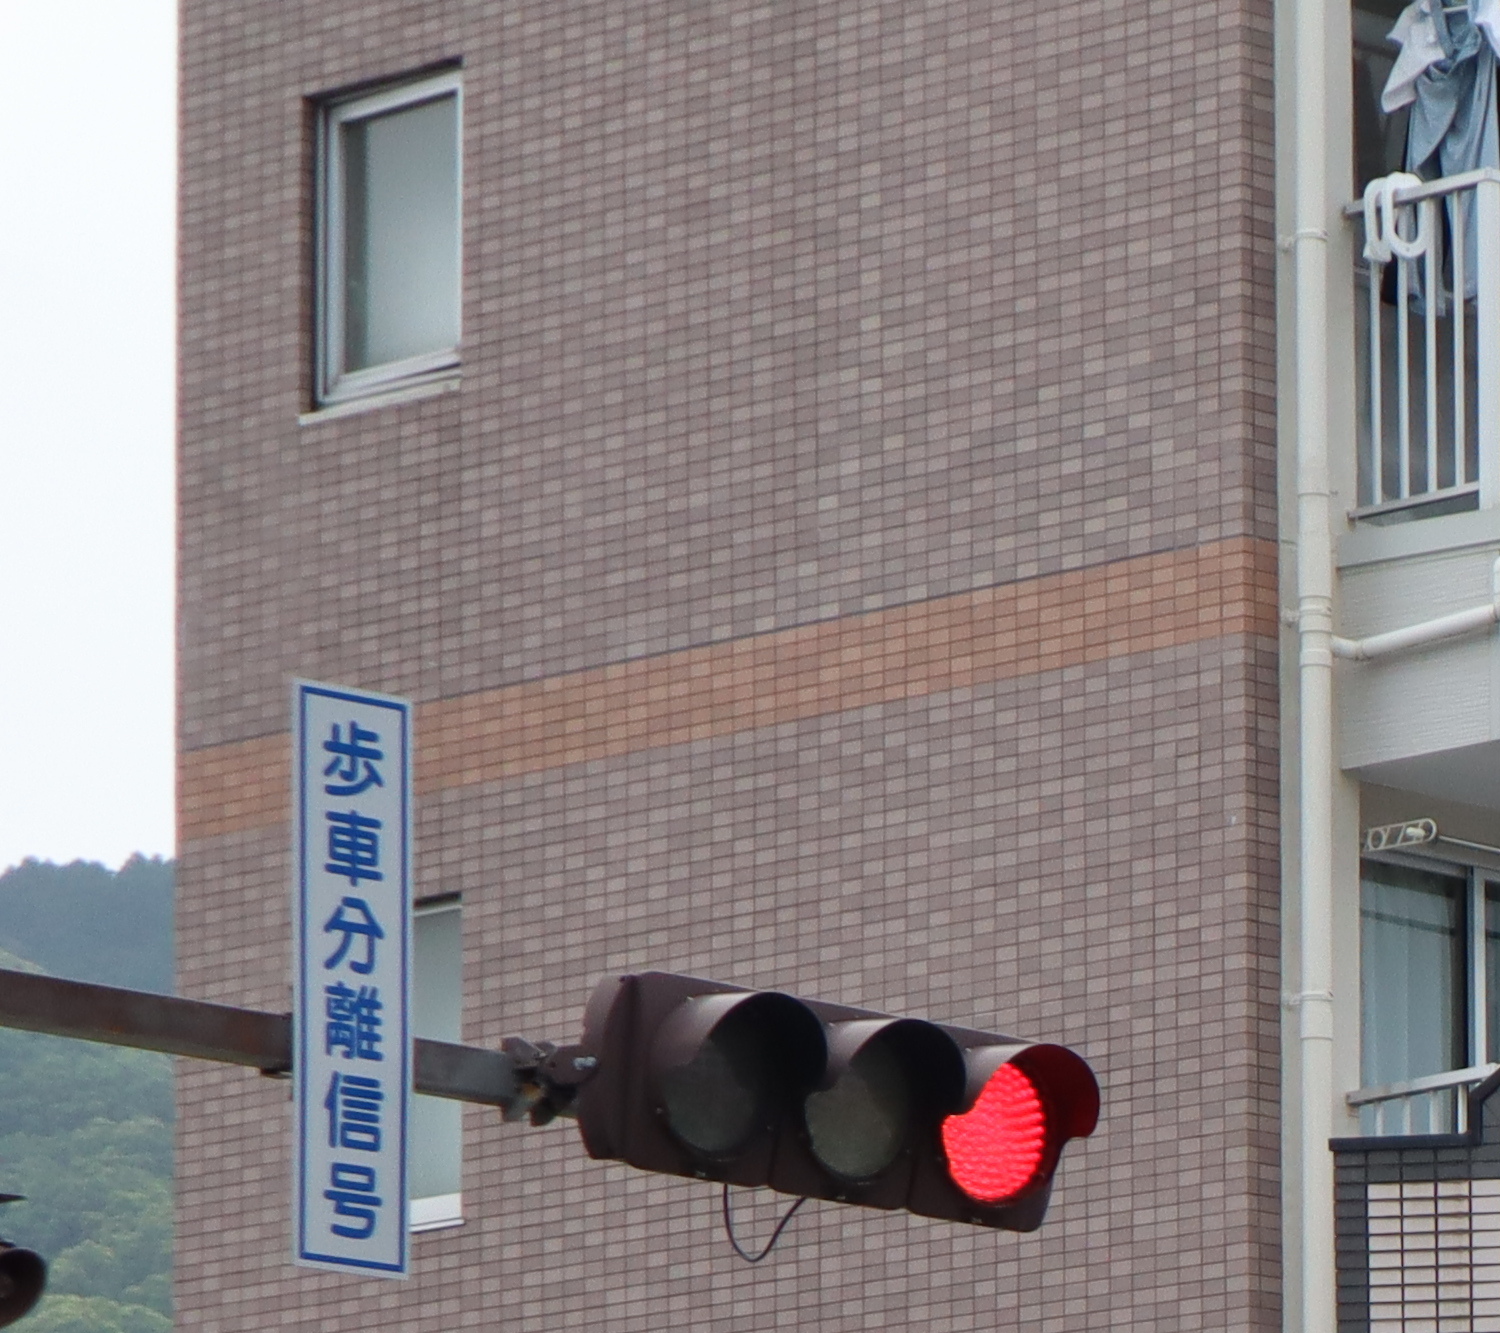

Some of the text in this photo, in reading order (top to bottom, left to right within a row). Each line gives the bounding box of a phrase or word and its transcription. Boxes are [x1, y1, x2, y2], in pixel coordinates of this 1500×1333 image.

[321, 720, 386, 1242] 歩車分離信号
